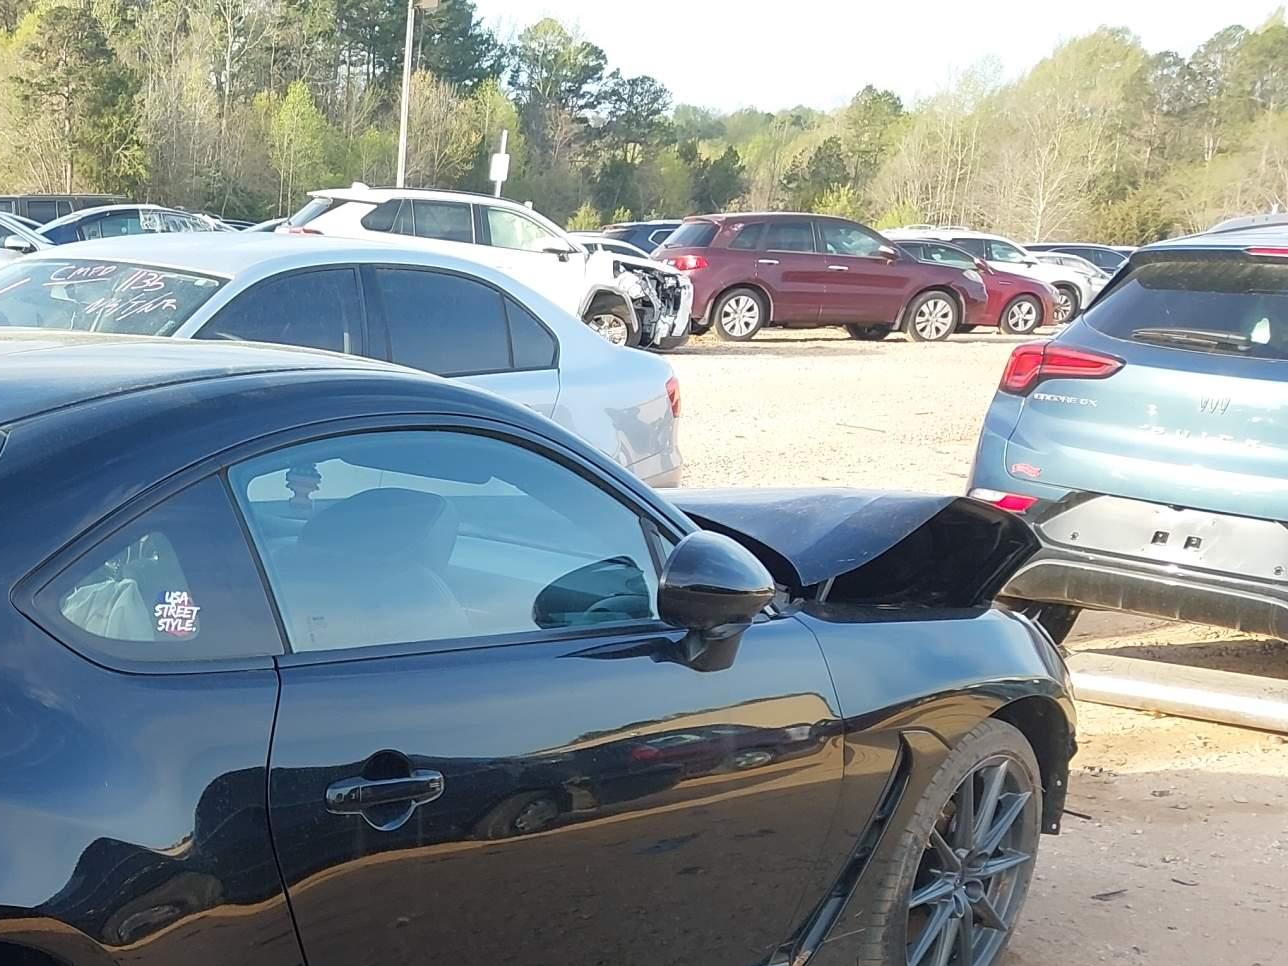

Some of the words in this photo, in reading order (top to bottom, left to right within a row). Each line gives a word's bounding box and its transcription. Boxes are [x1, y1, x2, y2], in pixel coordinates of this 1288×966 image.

[164, 591, 189, 606] USA
[154, 604, 201, 621] STREET
[157, 618, 197, 632] STYLE.
